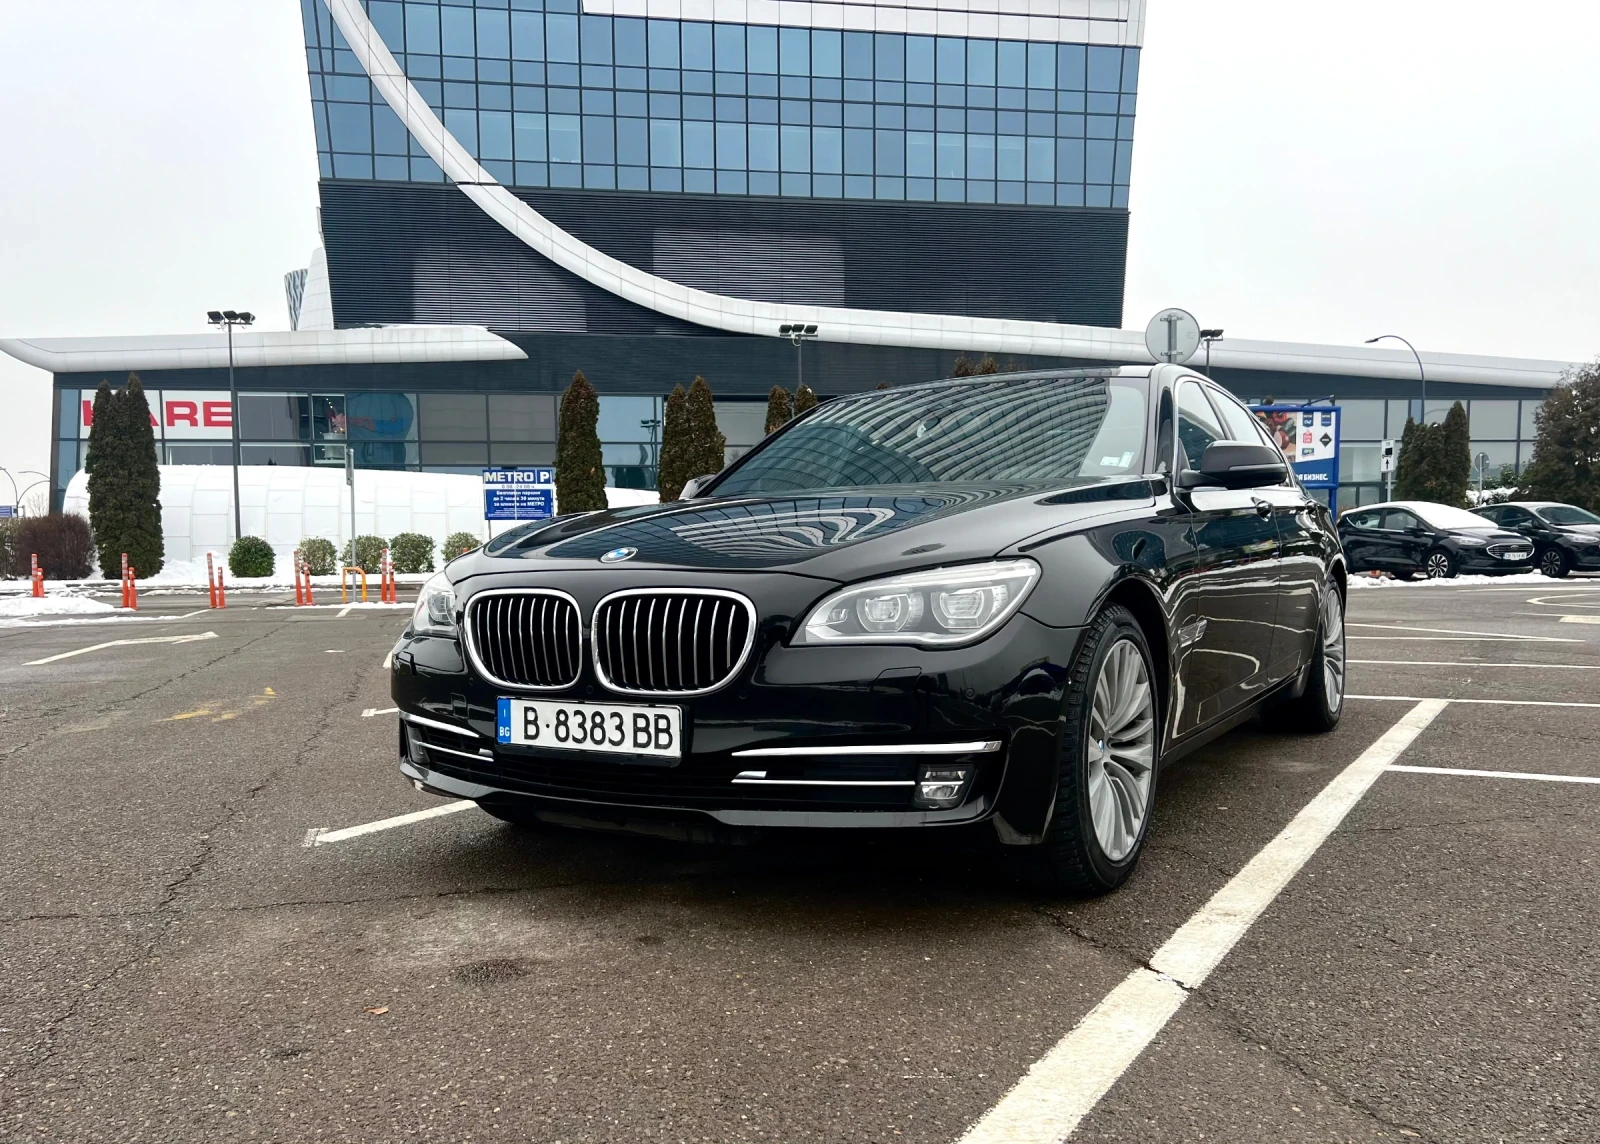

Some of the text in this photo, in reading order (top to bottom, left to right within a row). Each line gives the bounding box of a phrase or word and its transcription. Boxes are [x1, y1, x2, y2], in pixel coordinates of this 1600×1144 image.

[82, 400, 232, 427] RE
[485, 472, 549, 482] METRO P
[499, 726, 510, 737] BG
